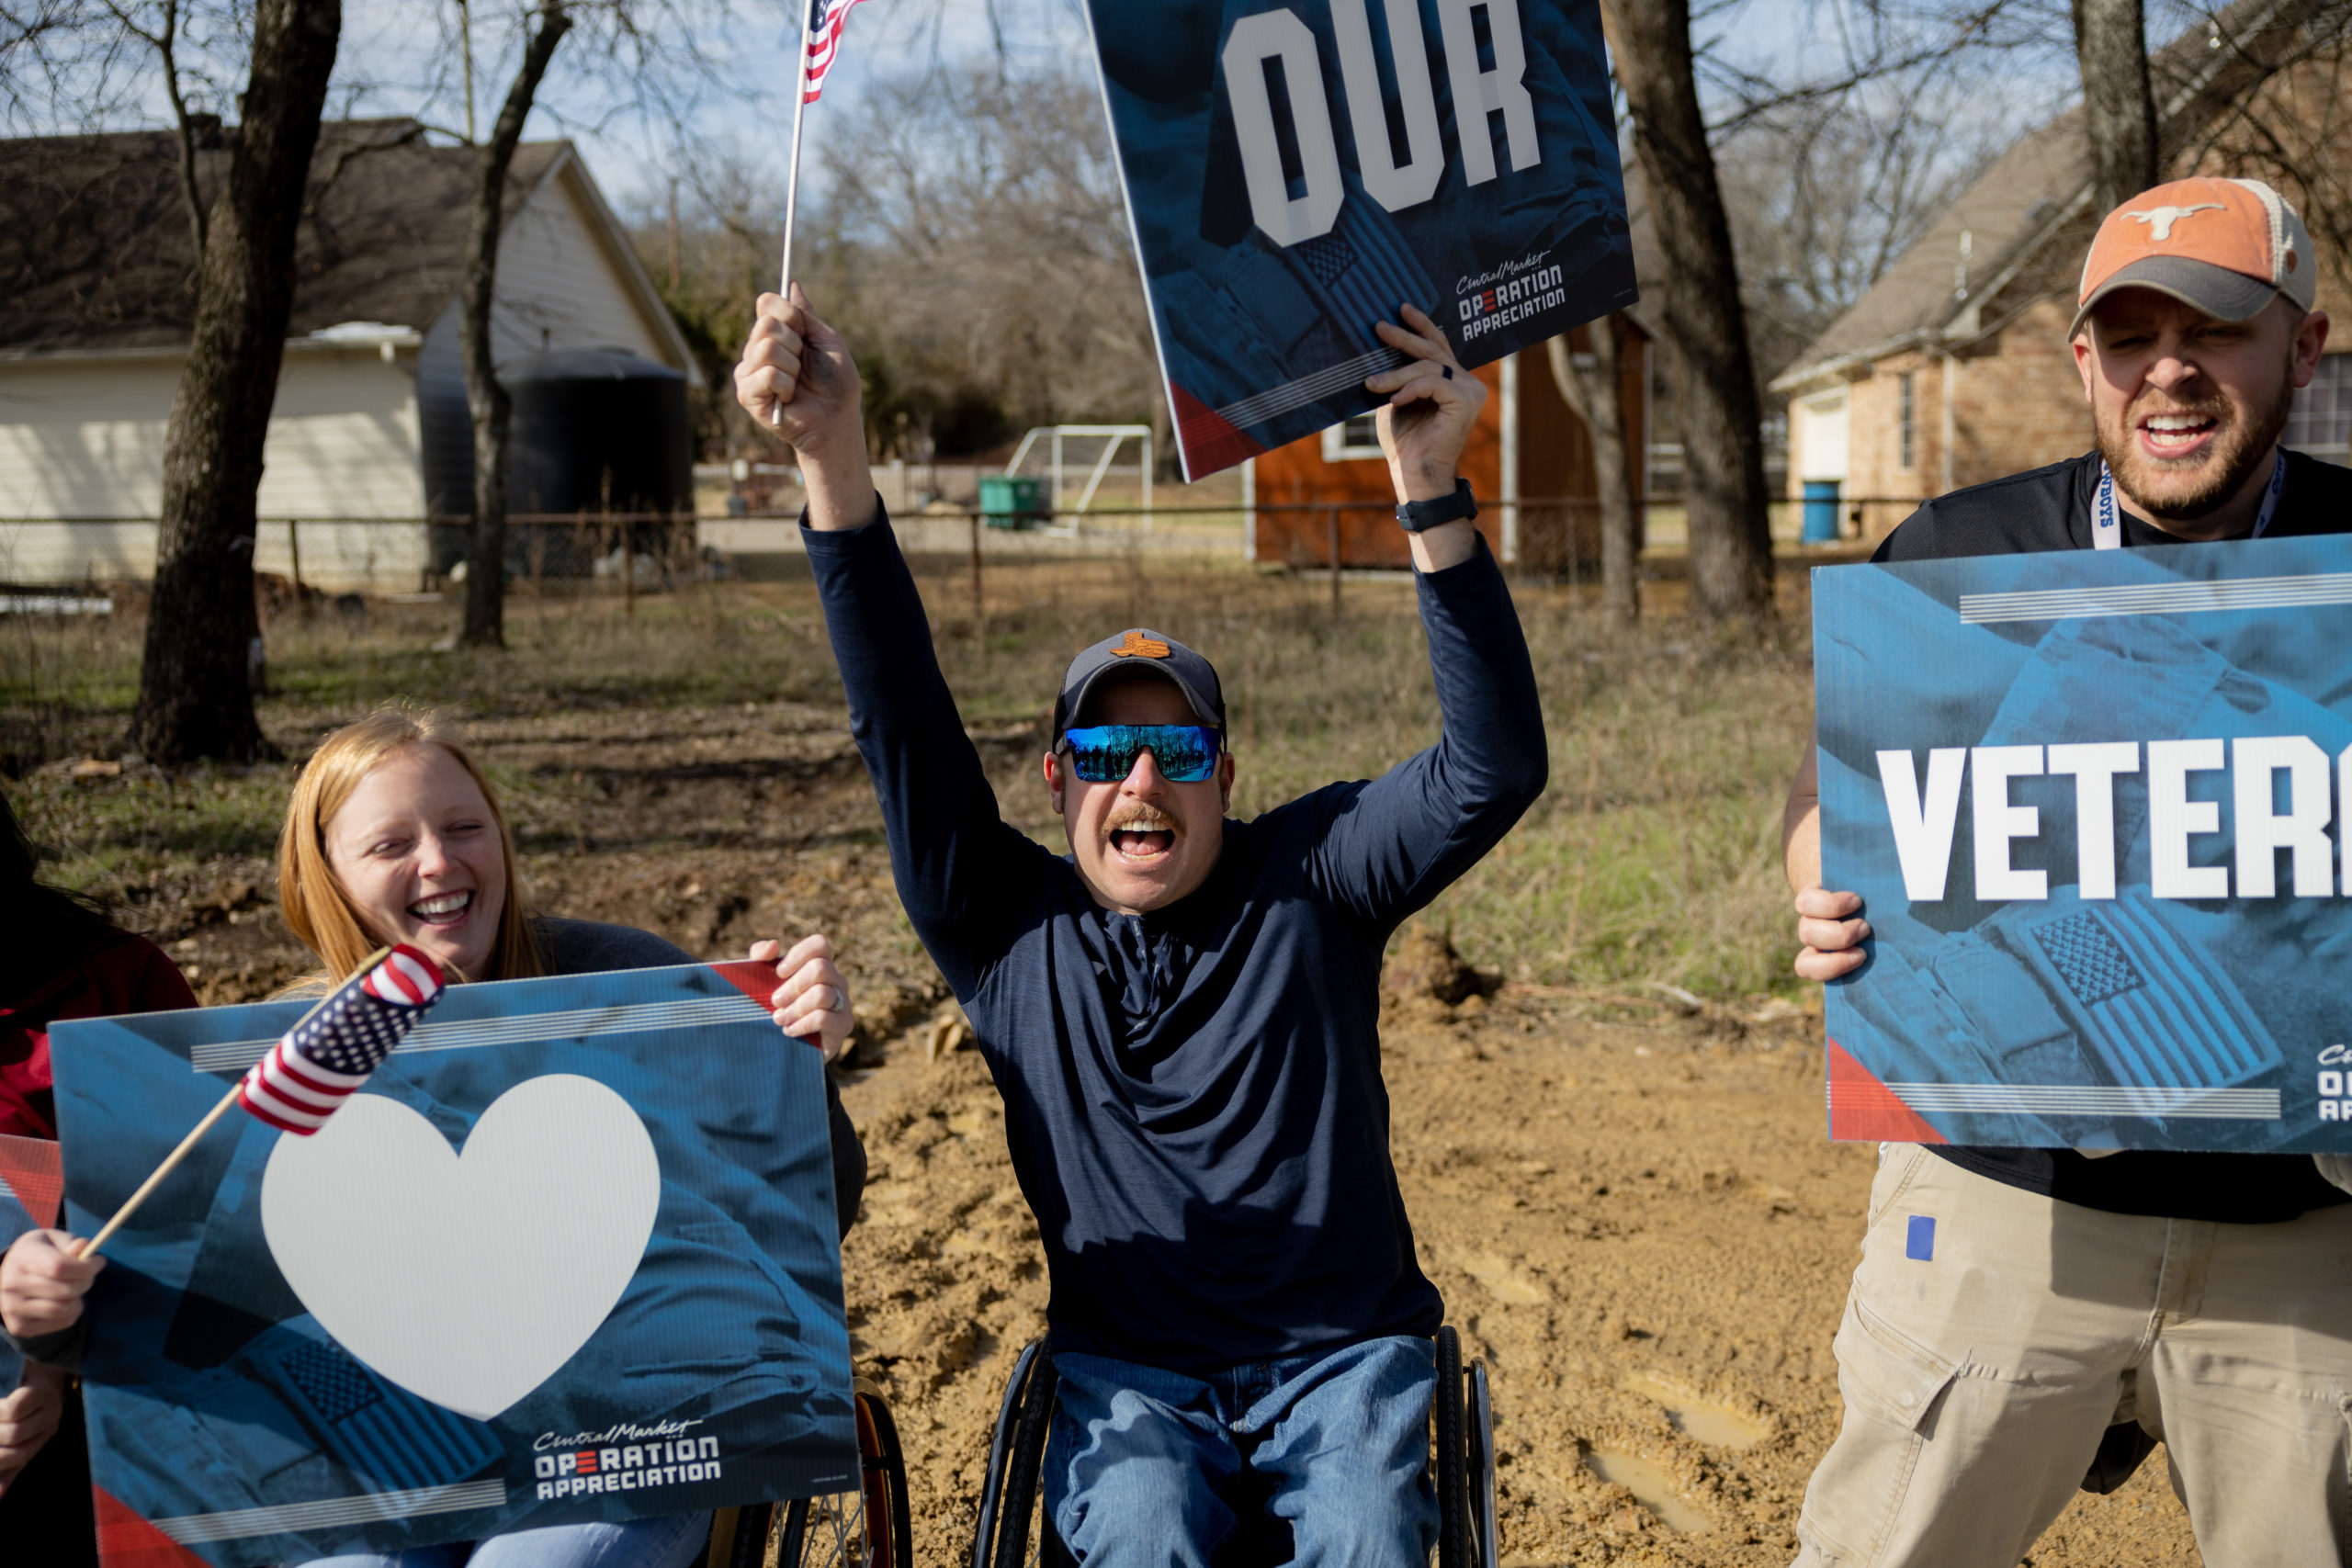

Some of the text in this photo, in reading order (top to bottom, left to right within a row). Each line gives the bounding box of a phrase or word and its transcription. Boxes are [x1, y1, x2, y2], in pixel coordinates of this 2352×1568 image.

[1221, 0, 1542, 248] OUR
[1458, 265, 1563, 321] OPERATION
[1463, 288, 1566, 342] APPRECIATION
[535, 1436, 719, 1479] OPERATION
[537, 1461, 721, 1500] APPRECIATION
